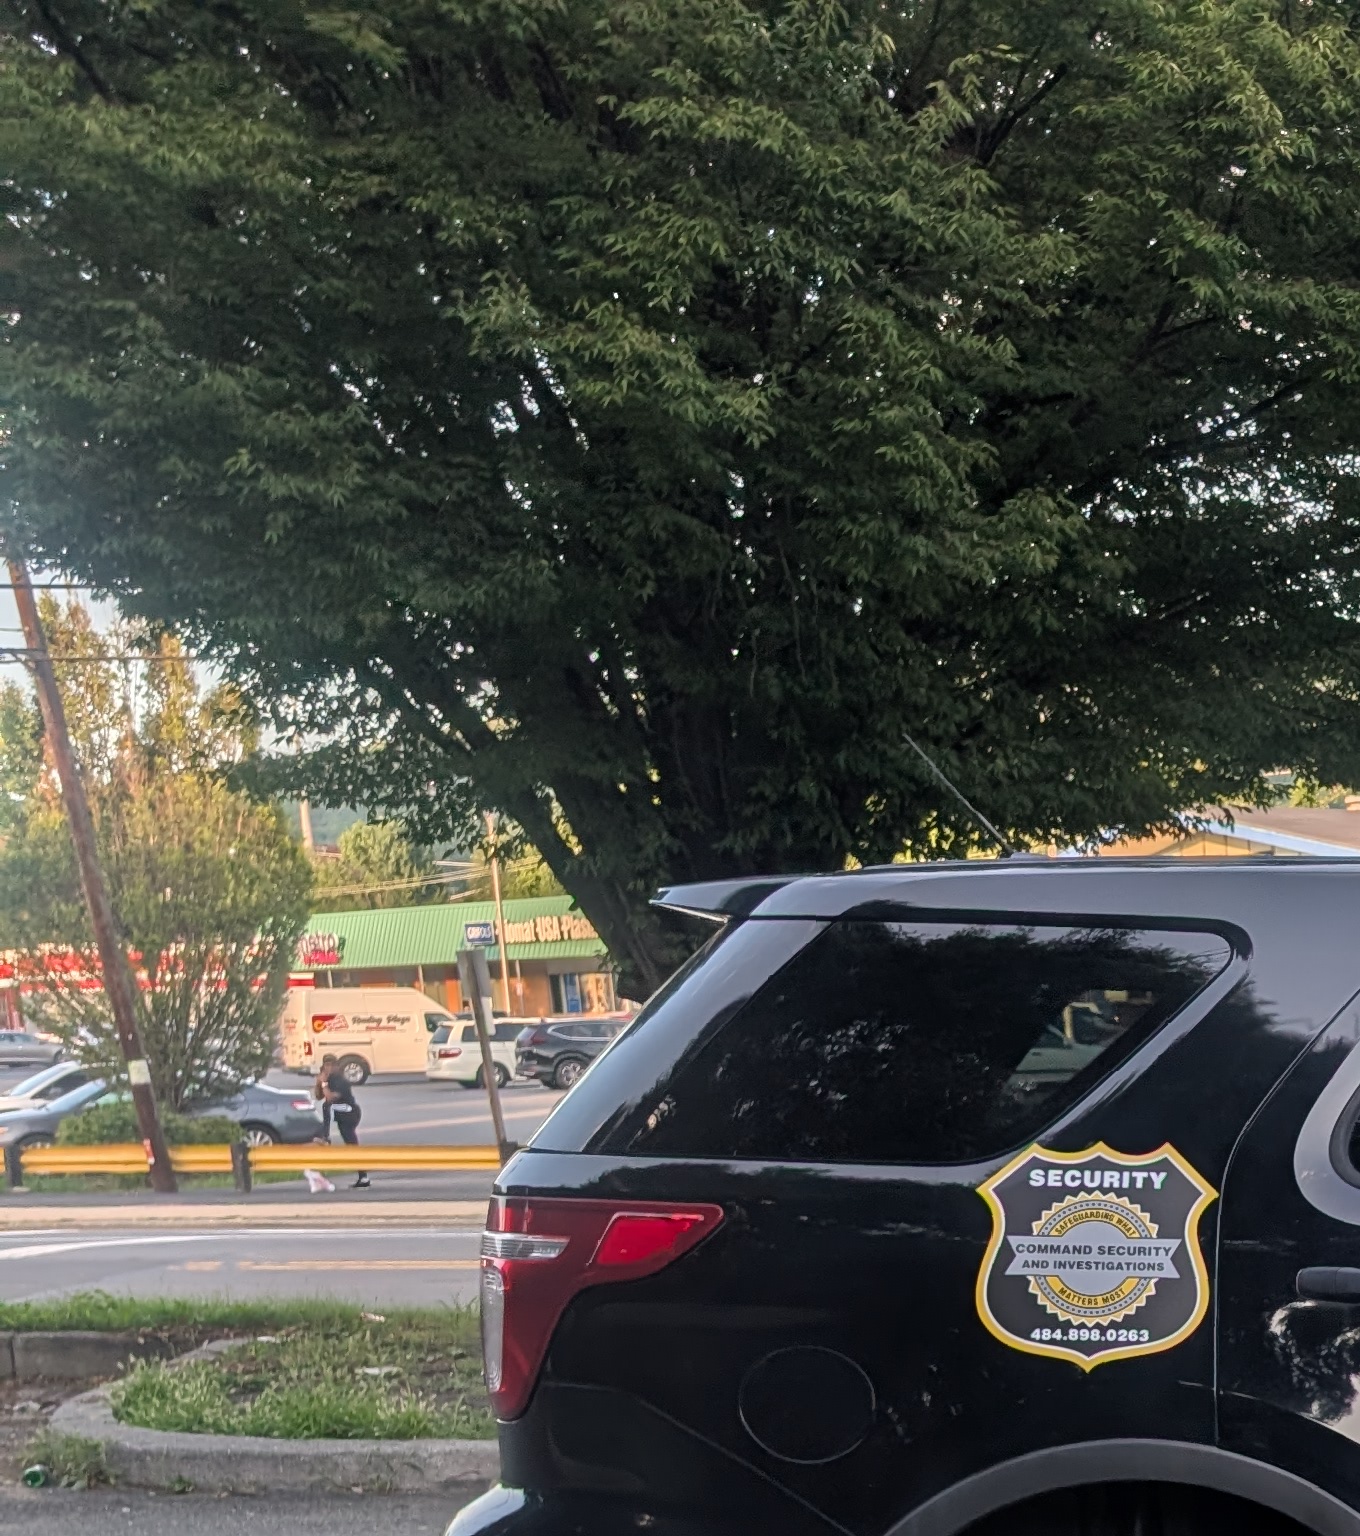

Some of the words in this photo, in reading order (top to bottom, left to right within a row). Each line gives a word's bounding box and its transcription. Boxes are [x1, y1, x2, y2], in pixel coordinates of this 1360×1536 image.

[535, 914, 562, 943] USA
[1029, 1169, 1168, 1189] SECURITY
[1054, 1211, 1115, 1235] SAFEGUARDING
[1115, 1217, 1137, 1237] WHAT
[1015, 1243, 1093, 1255] COMMAND
[1097, 1245, 1173, 1257] SECURITY
[1021, 1259, 1050, 1270] AND
[1053, 1260, 1165, 1272] INVESTIGATIONS
[1057, 1287, 1099, 1306] MATTERS
[1101, 1288, 1126, 1304] MOST
[1030, 1328, 1150, 1342] 484.898.0263
